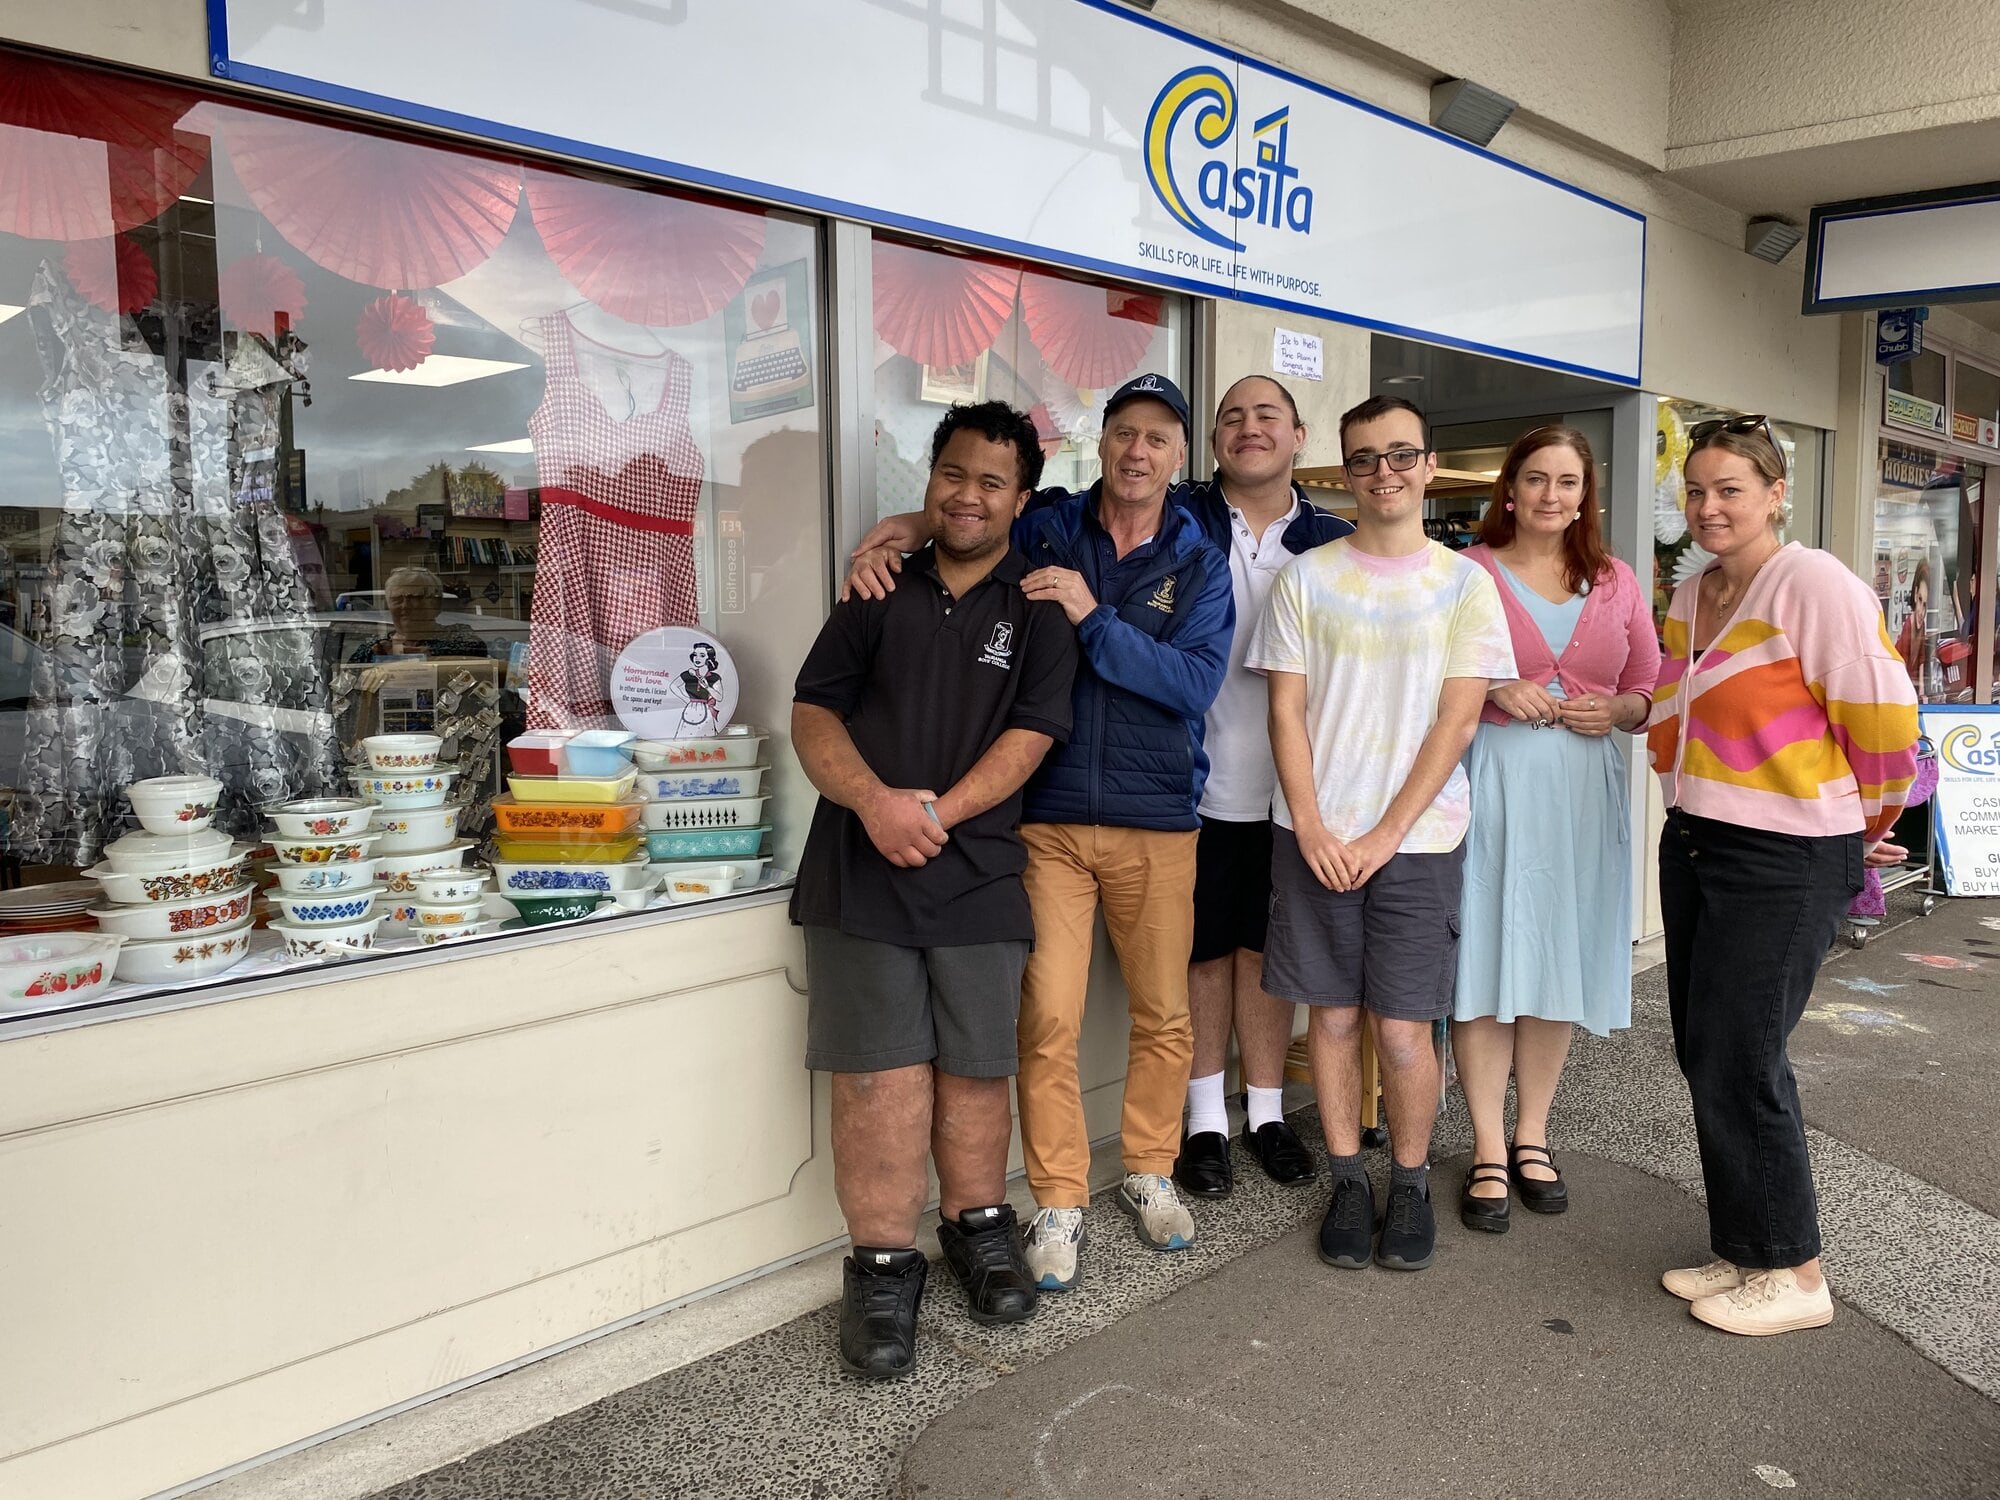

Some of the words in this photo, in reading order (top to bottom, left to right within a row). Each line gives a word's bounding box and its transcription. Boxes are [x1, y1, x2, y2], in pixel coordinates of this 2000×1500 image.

[1143, 66, 1314, 254] Casita
[1138, 242, 1175, 264] SKILLS
[1177, 250, 1199, 270] FOR
[1201, 255, 1225, 276] LIFE.
[1227, 262, 1248, 280] LIFE
[1250, 268, 1274, 287] WITH
[1276, 274, 1322, 298] PURPOSE.
[1293, 337, 1299, 346] to
[1302, 338, 1317, 349] theft
[1878, 343, 1909, 353] Chubb
[1884, 460, 1931, 487] HOBBIES
[625, 675, 642, 684] with
[622, 694, 630, 702] the
[652, 698, 662, 706] kept
[632, 706, 644, 714] using
[1974, 867, 1999, 878] BUY
[1962, 881, 1987, 892] BUY
